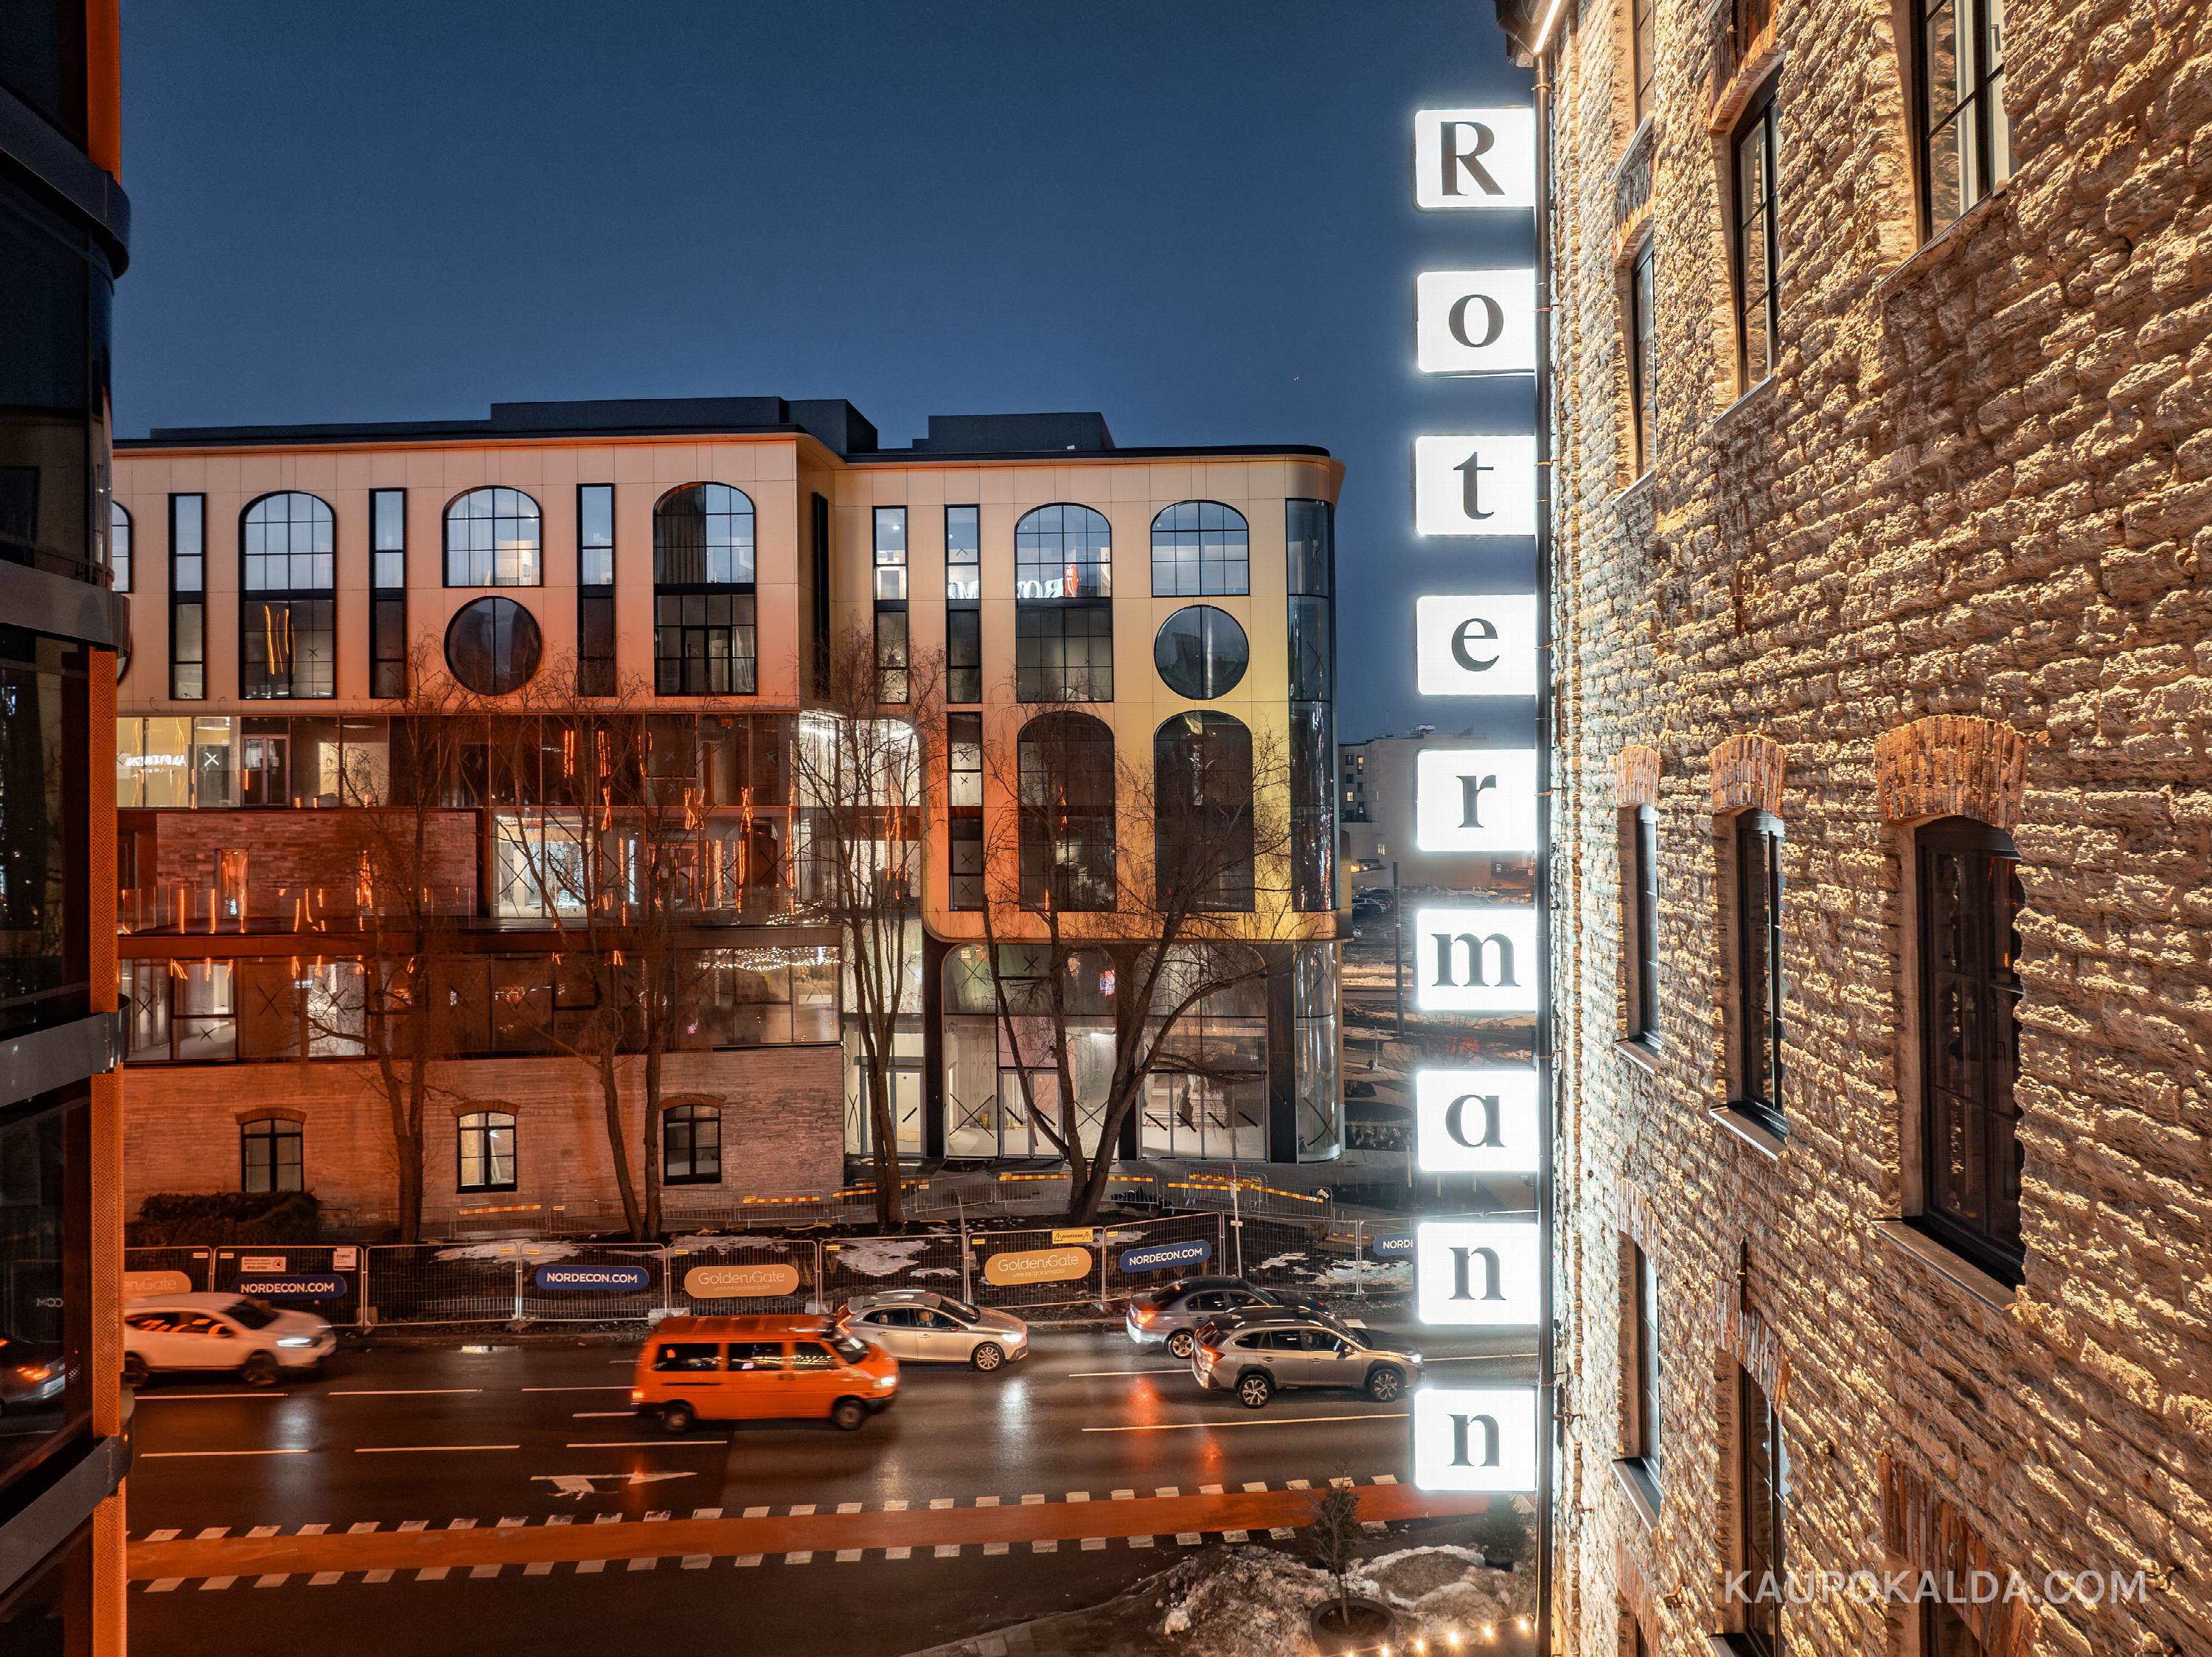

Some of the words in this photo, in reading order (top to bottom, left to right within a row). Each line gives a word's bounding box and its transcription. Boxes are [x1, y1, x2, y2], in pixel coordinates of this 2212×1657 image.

[1430, 121, 1521, 1467] Rotermann
[1129, 1246, 1203, 1266] NORDECON.COM
[546, 1272, 638, 1283] NORDECON.COM
[240, 1282, 334, 1293] NORDECON.COM
